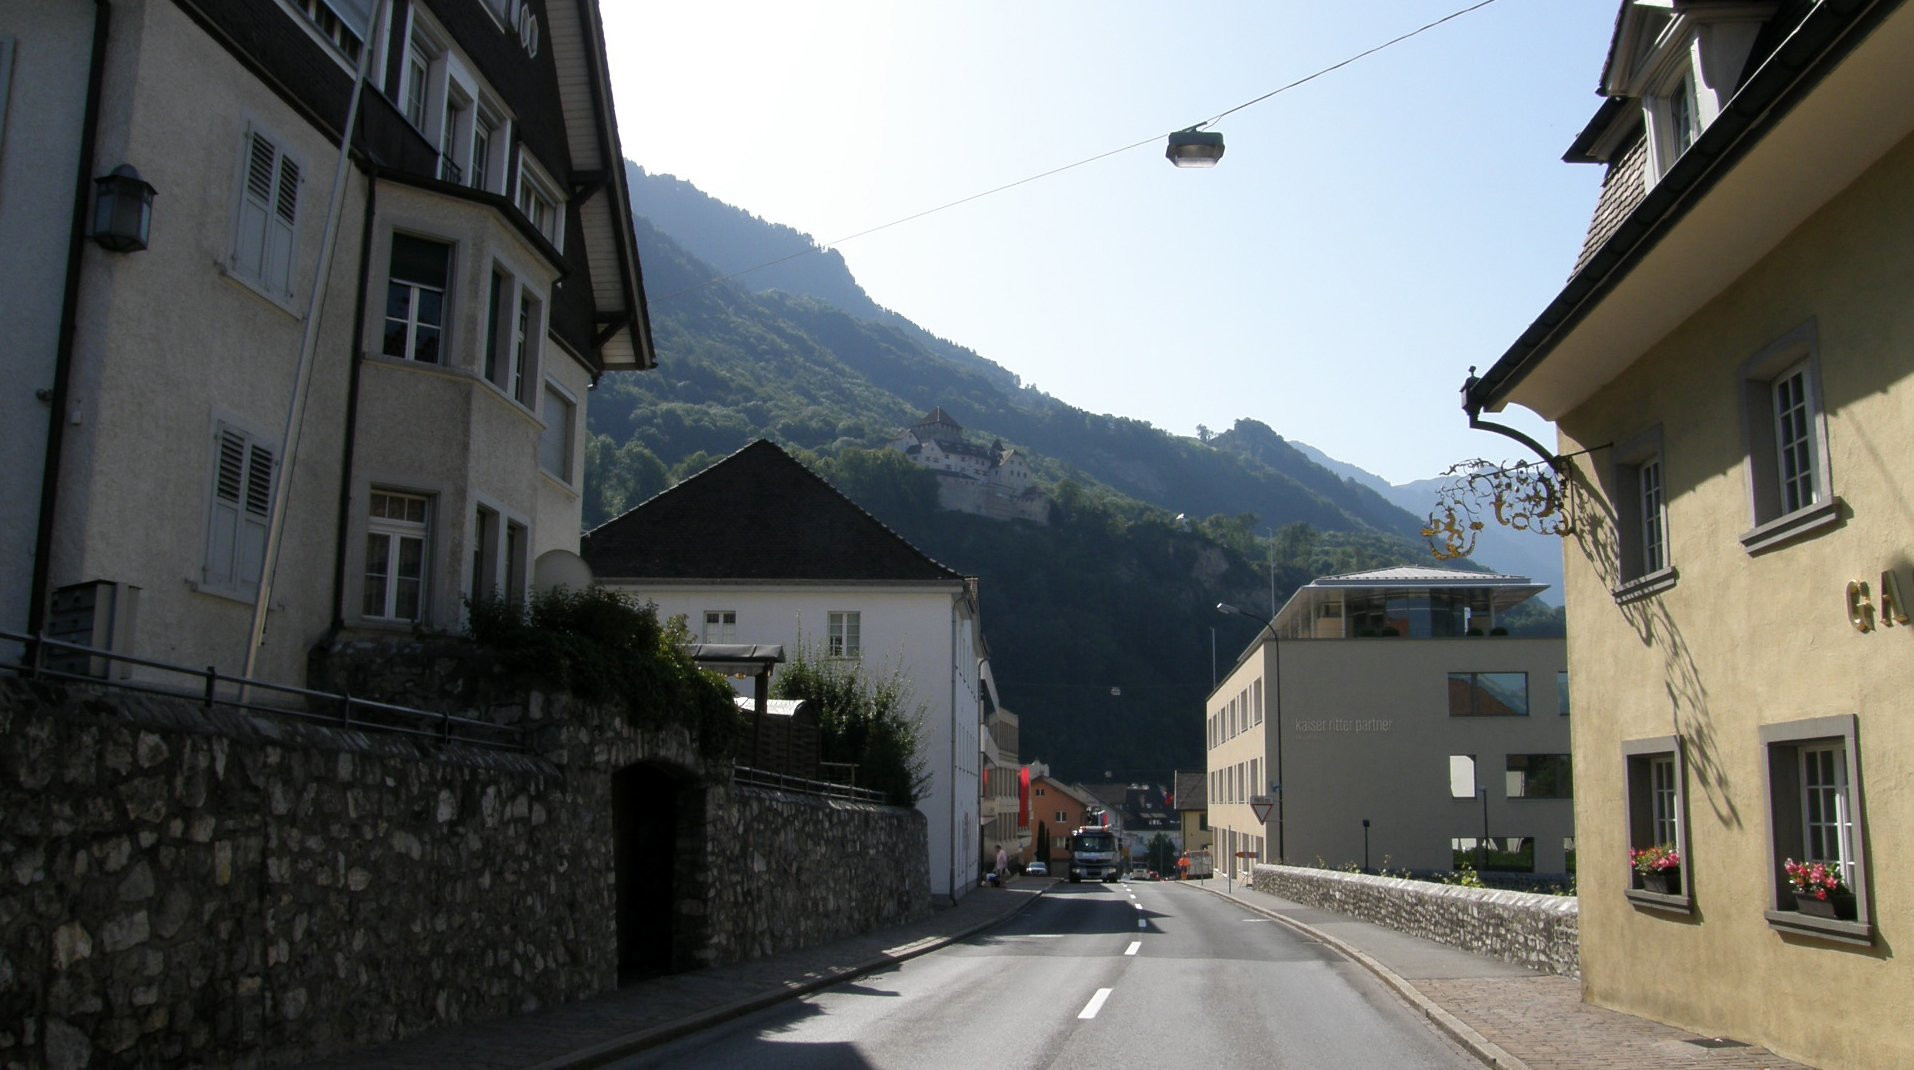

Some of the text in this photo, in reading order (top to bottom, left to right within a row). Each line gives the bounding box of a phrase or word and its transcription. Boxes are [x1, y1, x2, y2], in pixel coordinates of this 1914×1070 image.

[1846, 569, 1914, 634] GA
[1295, 717, 1393, 734] kaiser ritter partner
